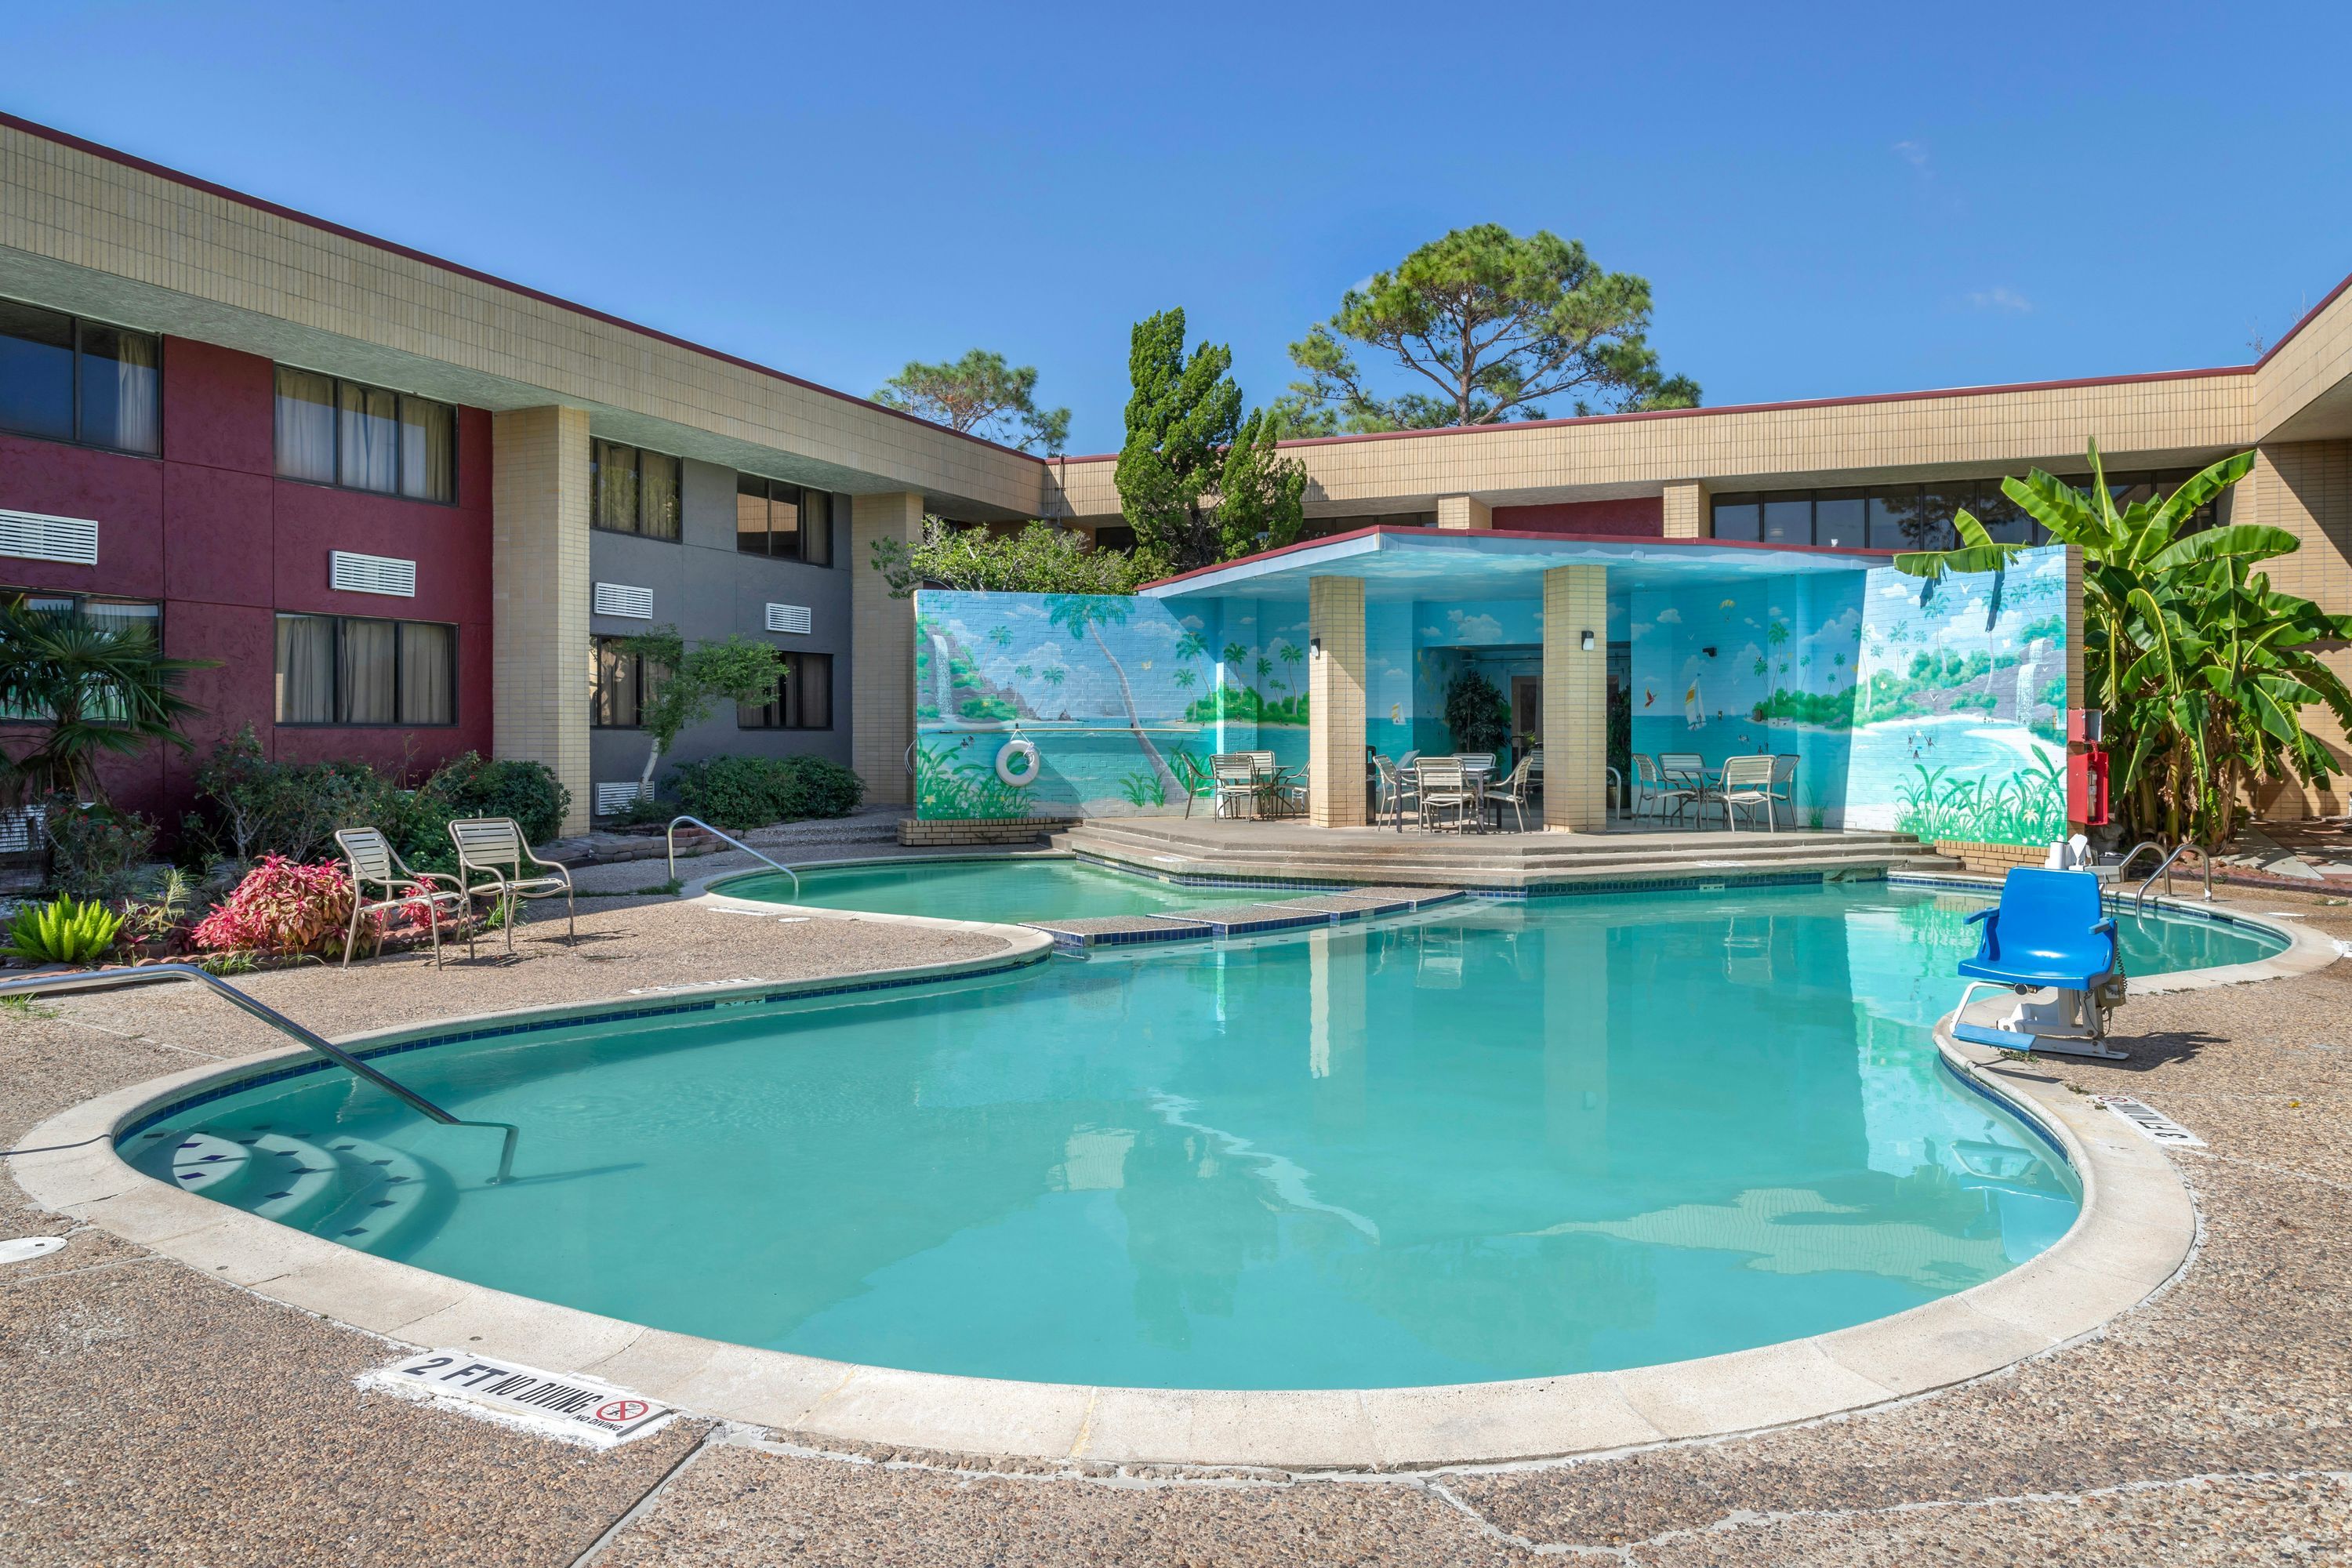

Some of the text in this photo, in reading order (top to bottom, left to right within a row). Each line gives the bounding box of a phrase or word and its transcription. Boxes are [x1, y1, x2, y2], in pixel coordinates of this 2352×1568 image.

[2136, 1120, 2179, 1131] FT
[402, 1357, 604, 1414] 2 FT NO DIVING
[587, 1418, 624, 1432] DIVING
